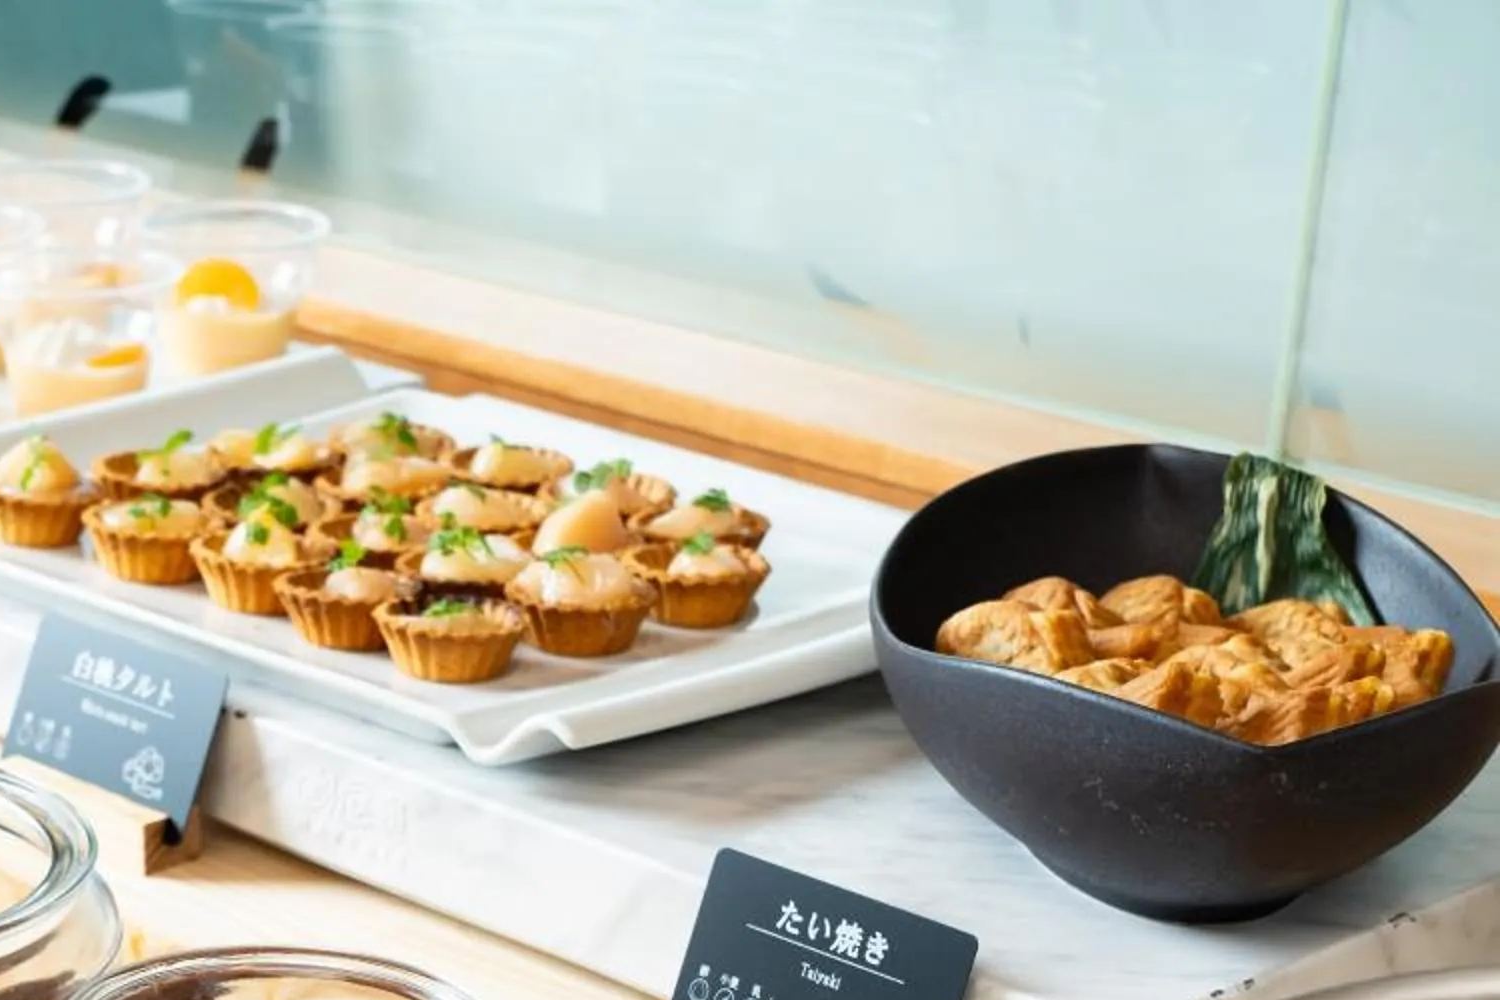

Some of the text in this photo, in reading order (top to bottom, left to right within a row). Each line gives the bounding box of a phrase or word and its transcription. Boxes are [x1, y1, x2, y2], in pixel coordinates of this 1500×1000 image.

[776, 899, 889, 965] たい焼き
[801, 961, 842, 991] Taiyaki
